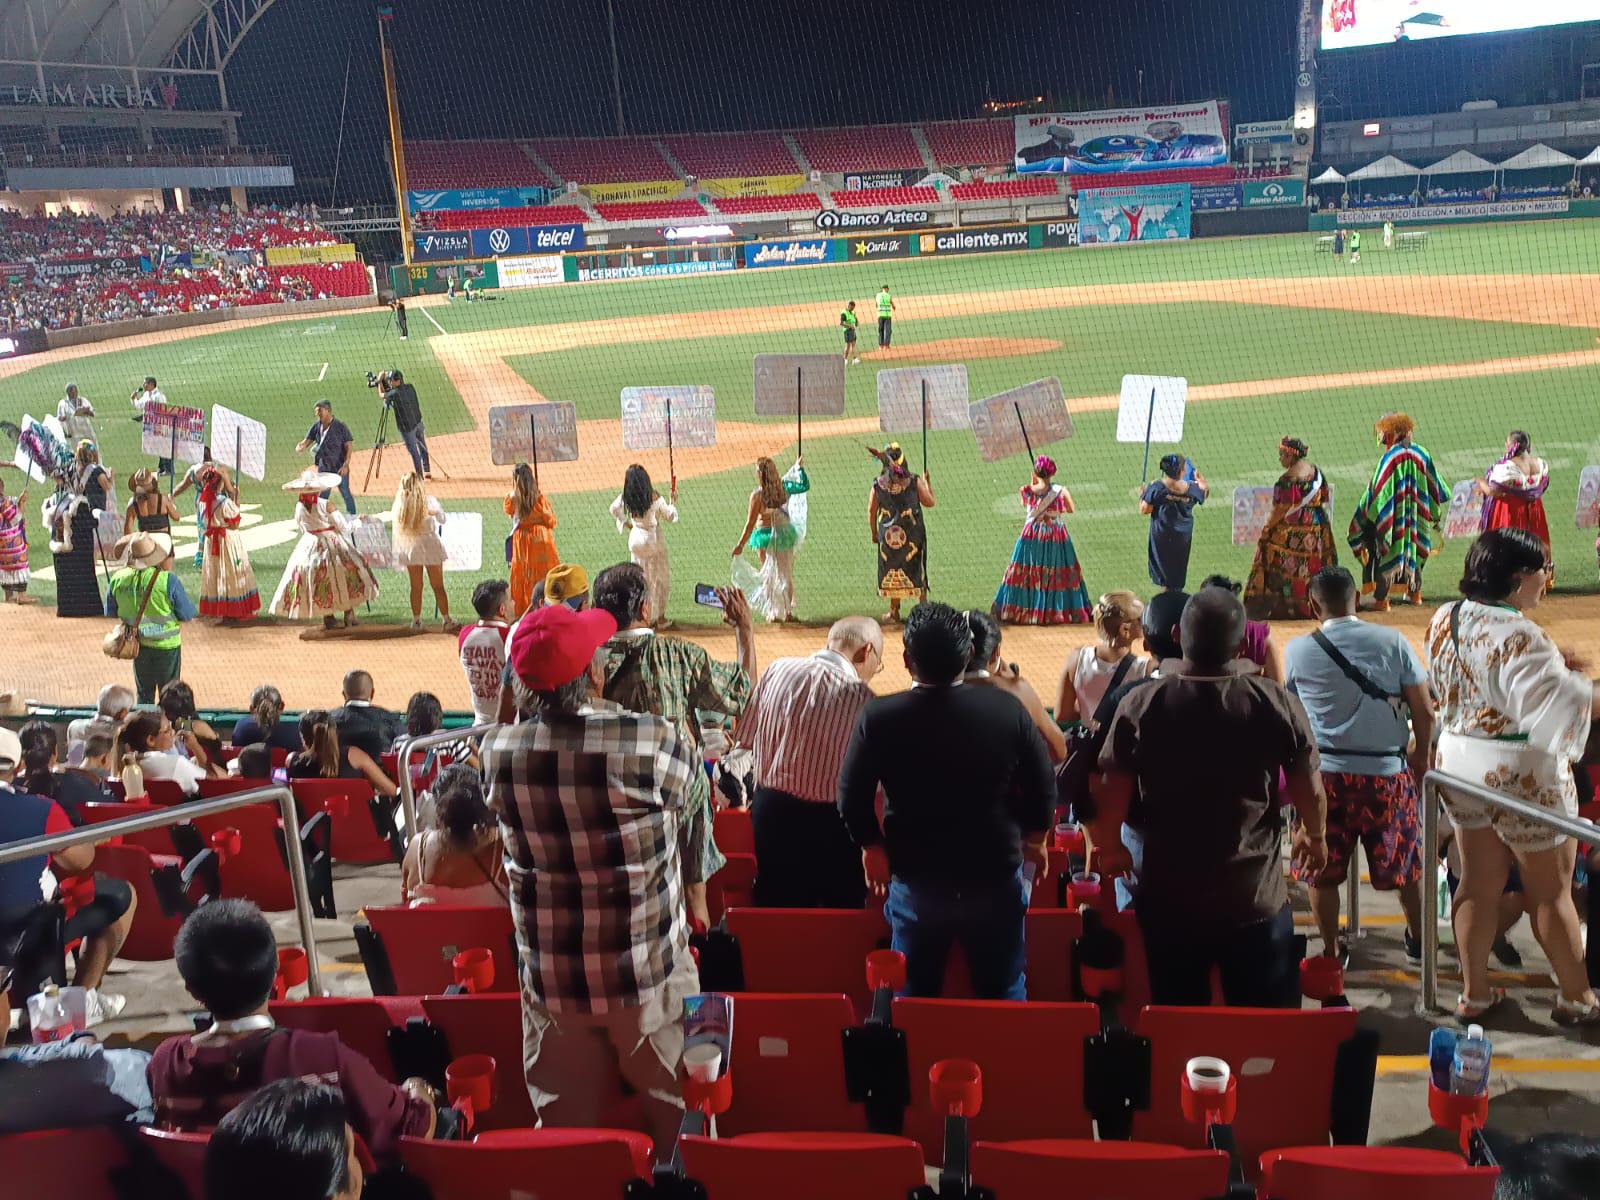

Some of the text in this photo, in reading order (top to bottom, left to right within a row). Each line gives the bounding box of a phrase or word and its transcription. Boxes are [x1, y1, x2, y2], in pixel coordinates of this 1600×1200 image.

[12, 85, 42, 103] LA
[841, 210, 928, 227] Banco Azteca
[434, 236, 468, 247] VIZSLA
[537, 228, 575, 248] telcel
[937, 231, 1028, 249] caliente.mx
[410, 267, 428, 279] 326
